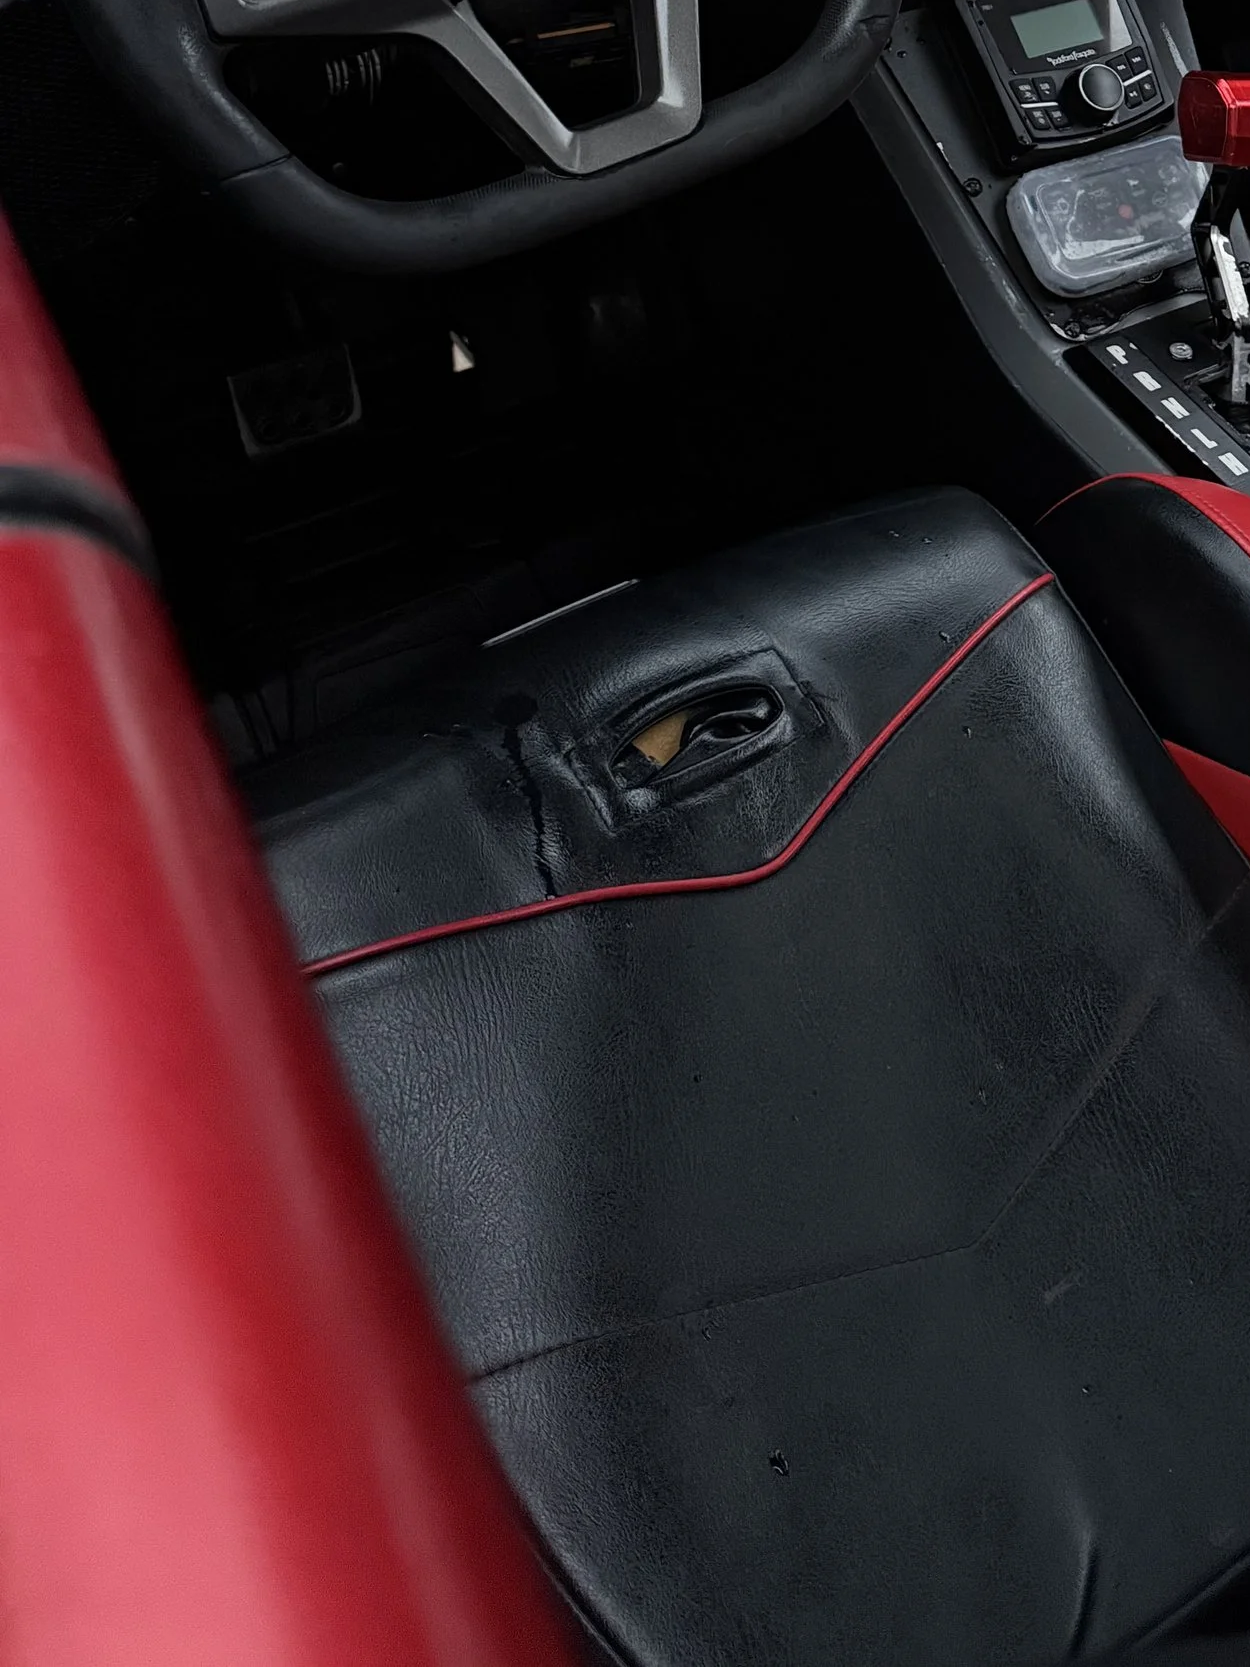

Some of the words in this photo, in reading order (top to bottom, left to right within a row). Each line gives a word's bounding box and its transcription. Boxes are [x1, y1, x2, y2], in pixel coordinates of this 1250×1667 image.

[1105, 344, 1129, 365] P
[1132, 371, 1162, 392] R
[1160, 397, 1190, 419] N
[1190, 428, 1218, 449] L
